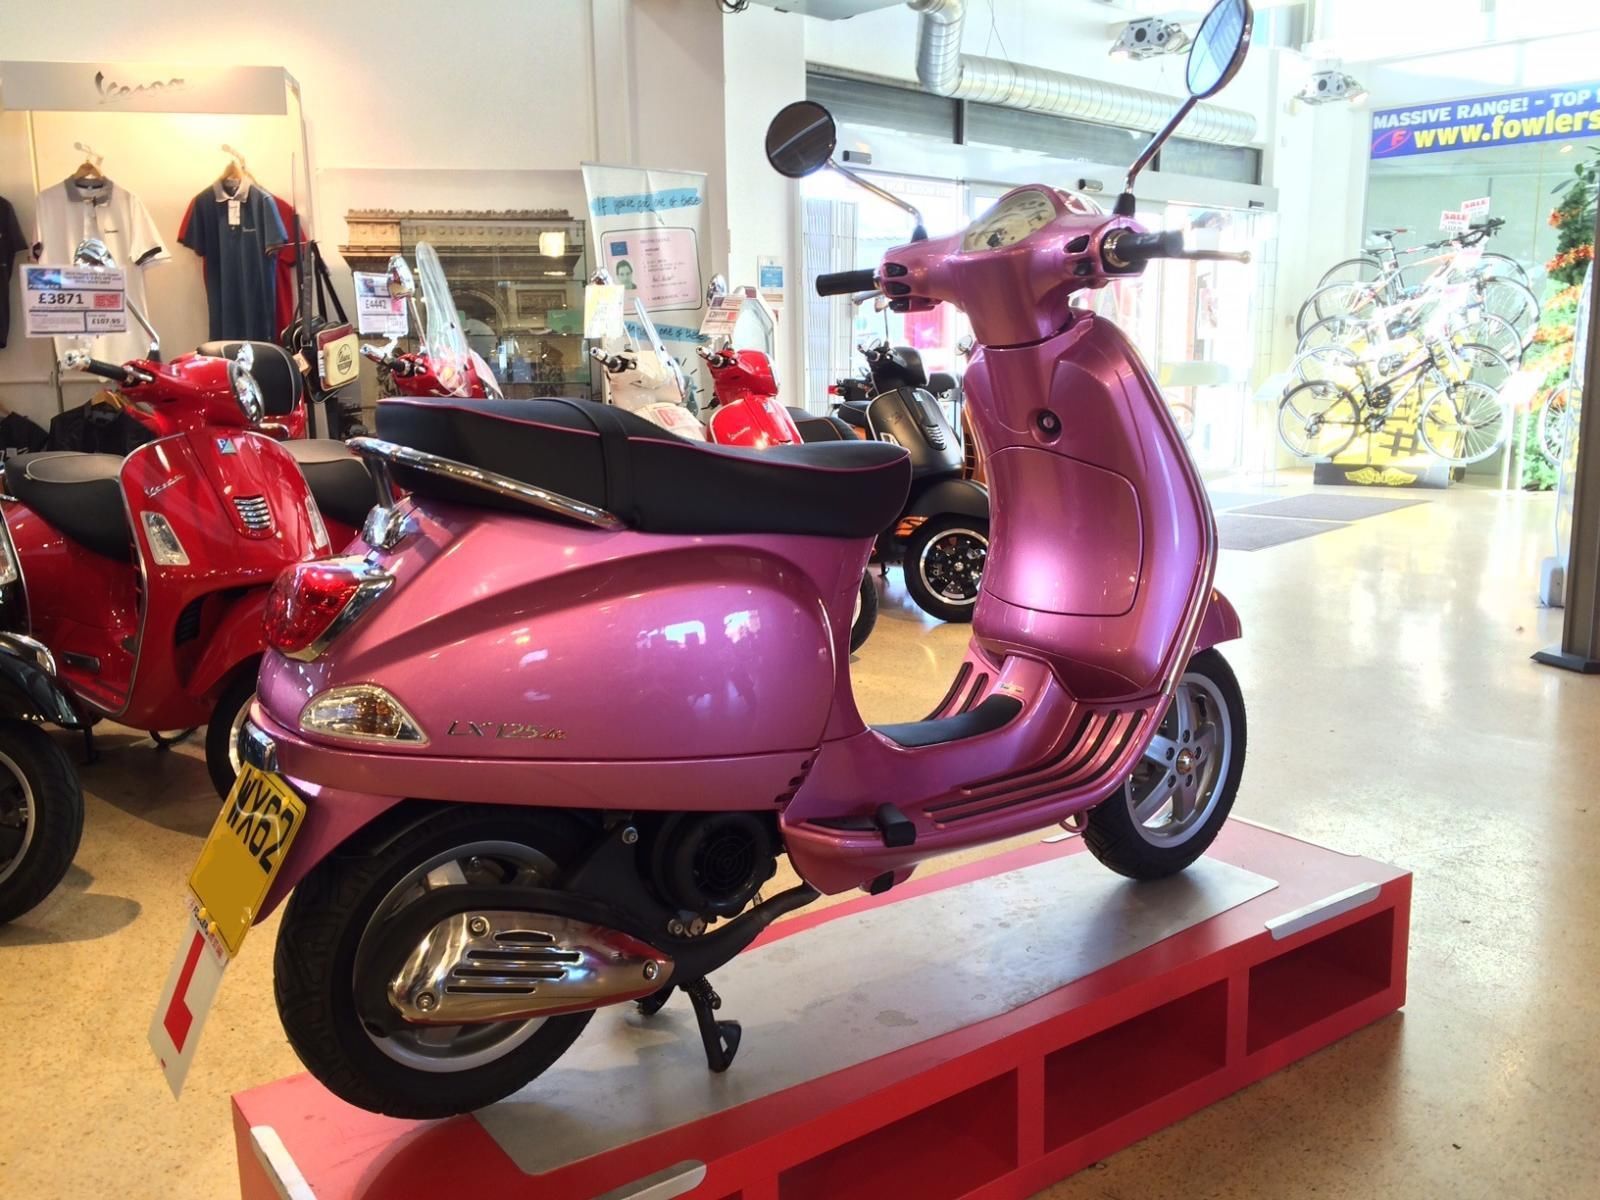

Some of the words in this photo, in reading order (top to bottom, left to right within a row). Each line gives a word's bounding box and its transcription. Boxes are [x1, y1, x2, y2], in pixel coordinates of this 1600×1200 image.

[1373, 106, 1452, 130] MASSIVE
[1456, 96, 1529, 120] RANGE!
[1550, 89, 1591, 108] TOP
[1443, 212, 1468, 221] SALE
[38, 293, 84, 304] £3871
